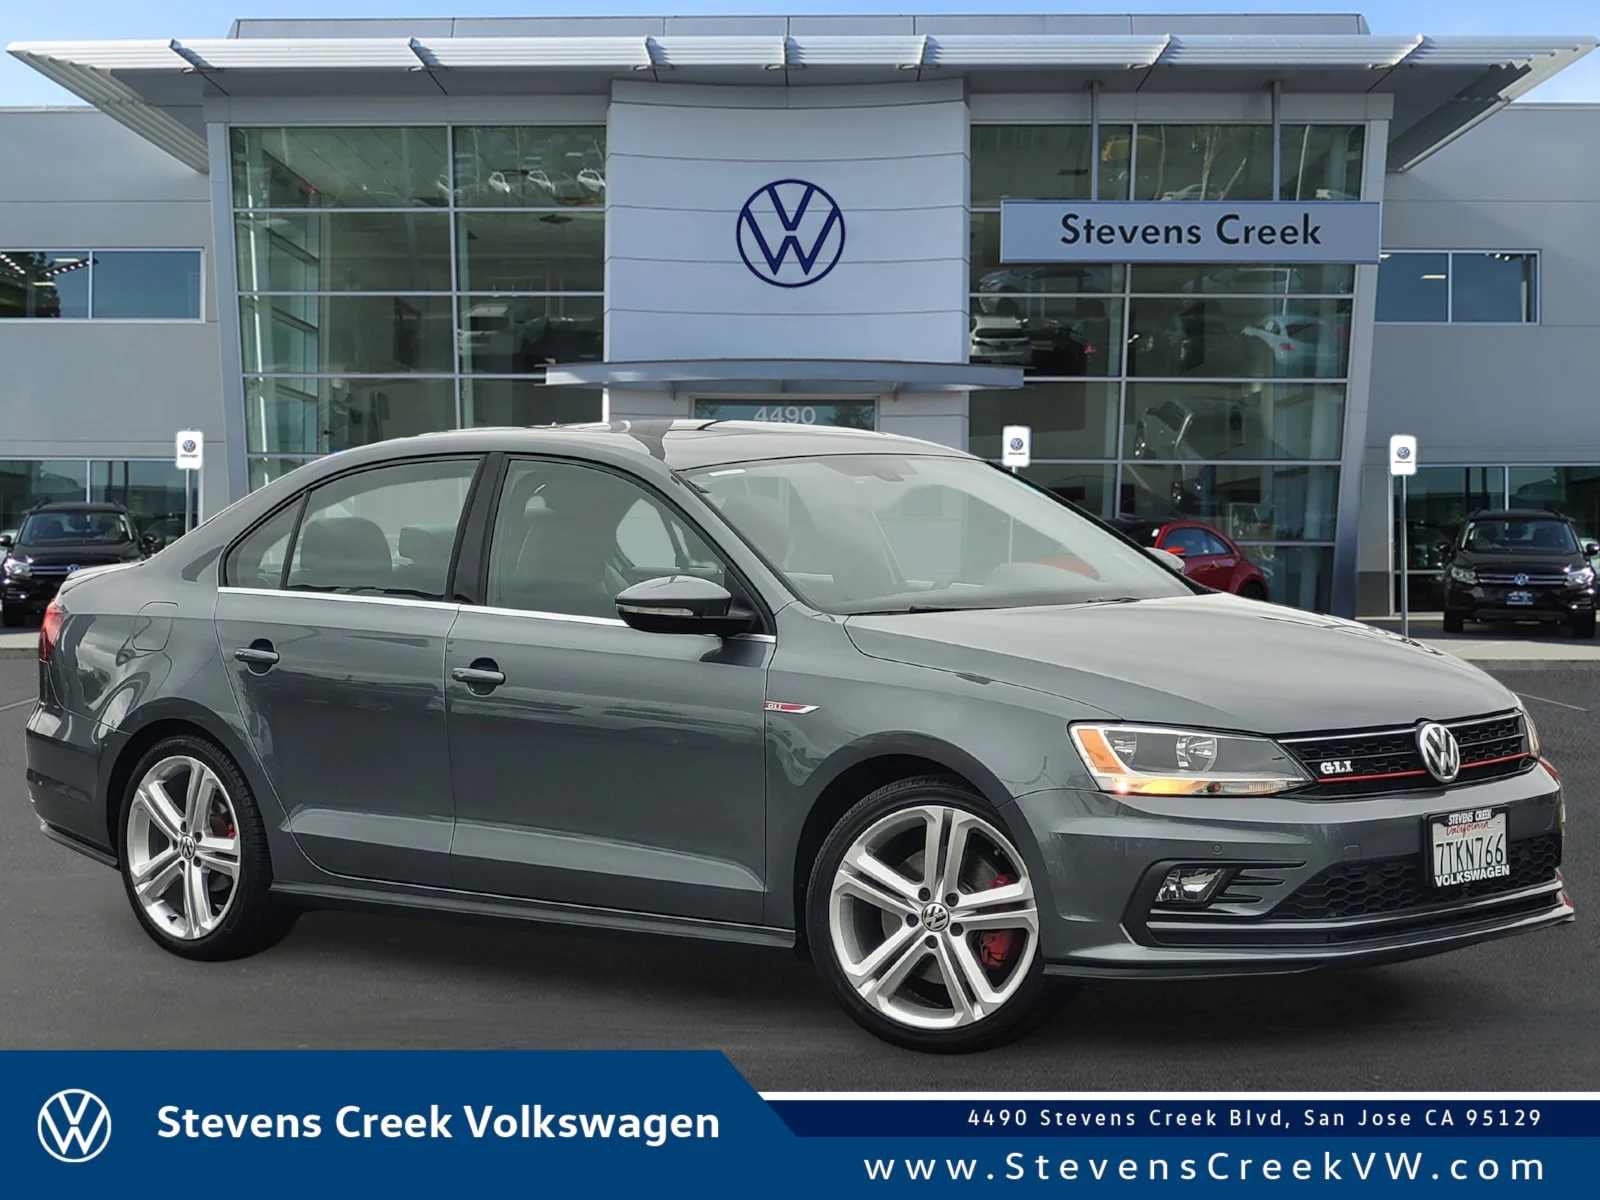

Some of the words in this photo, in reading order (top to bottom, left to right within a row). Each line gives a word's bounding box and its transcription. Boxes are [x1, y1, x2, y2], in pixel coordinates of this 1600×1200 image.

[1061, 213, 1201, 245] Stevens
[1216, 213, 1321, 245] Creek
[754, 405, 816, 424] 4490
[1320, 760, 1353, 775] GLI
[1448, 811, 1474, 826] STEVENS
[1474, 808, 1492, 822] CREEK
[1435, 832, 1504, 875] 7TKN766
[1434, 864, 1510, 888] VOLKSWAGEN
